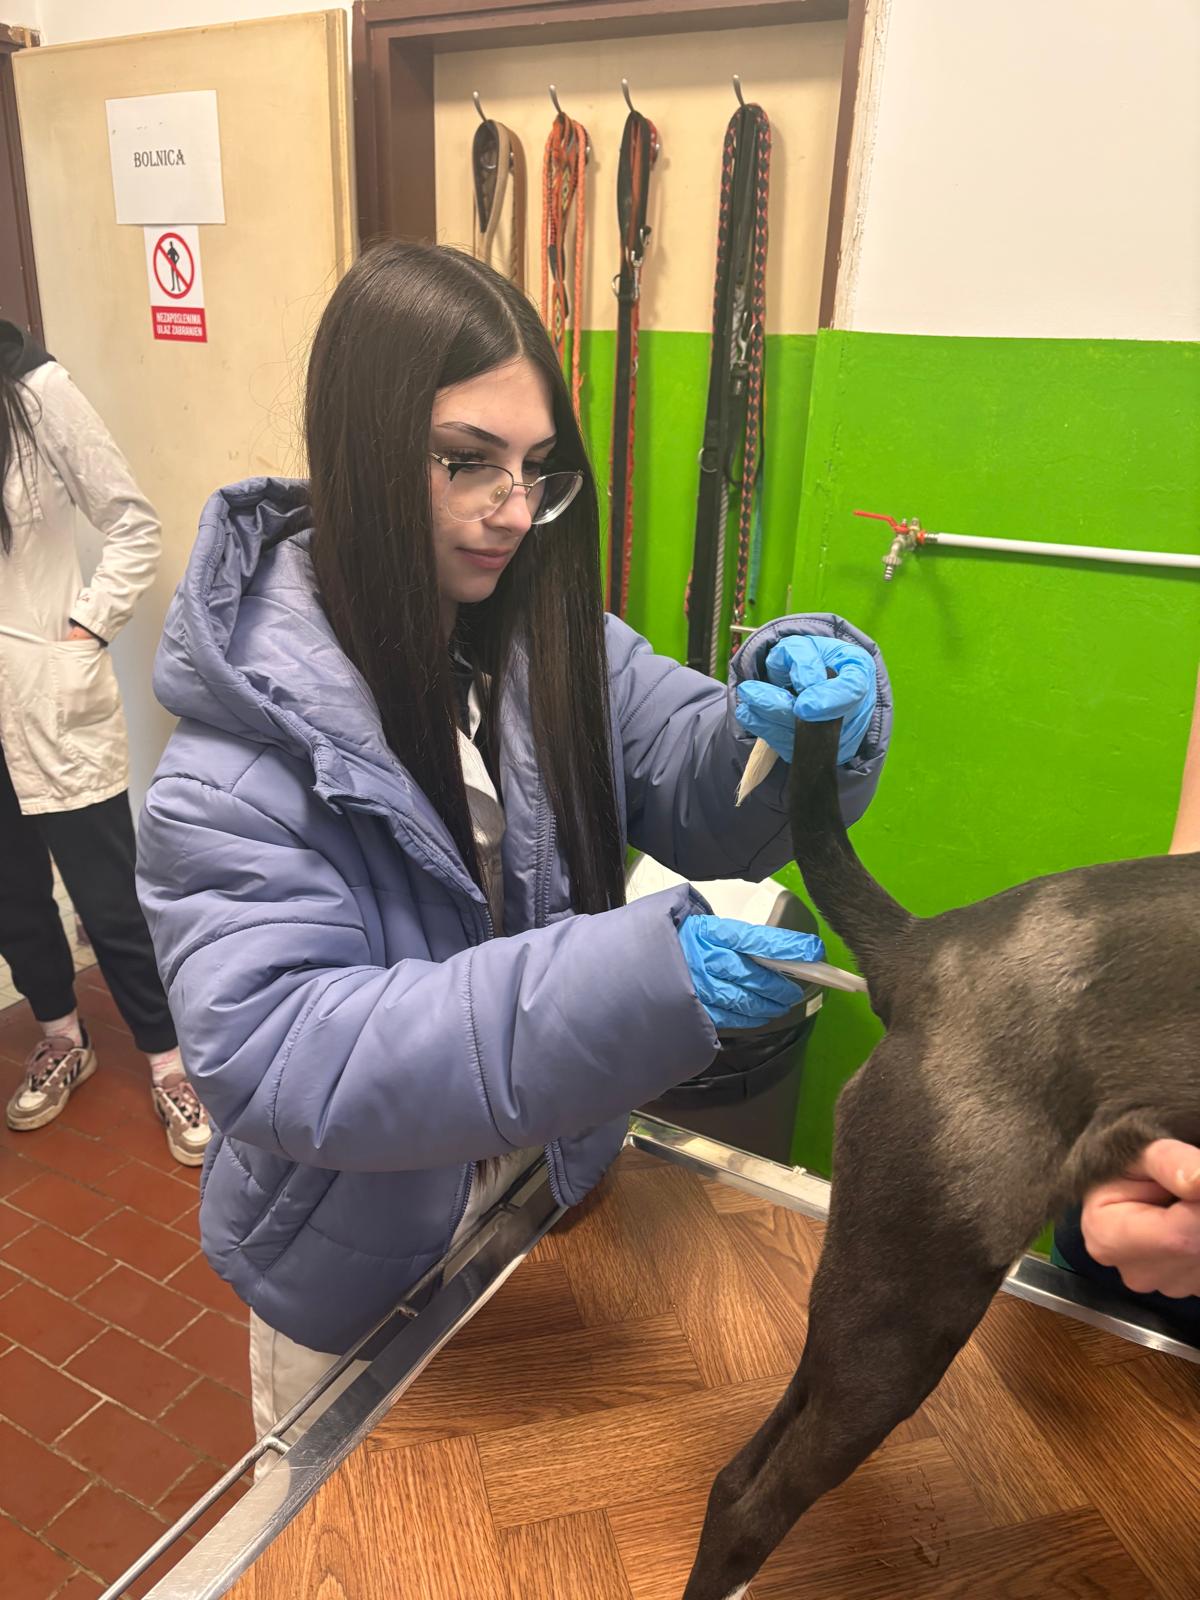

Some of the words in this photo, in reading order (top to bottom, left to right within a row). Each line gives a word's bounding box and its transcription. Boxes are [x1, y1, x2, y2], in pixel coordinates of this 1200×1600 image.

[134, 149, 186, 168] BOLNICA
[156, 312, 202, 325] NEZAPOSLENIMA
[156, 324, 171, 335] ULAZ
[172, 325, 203, 337] ZABRANJEN
